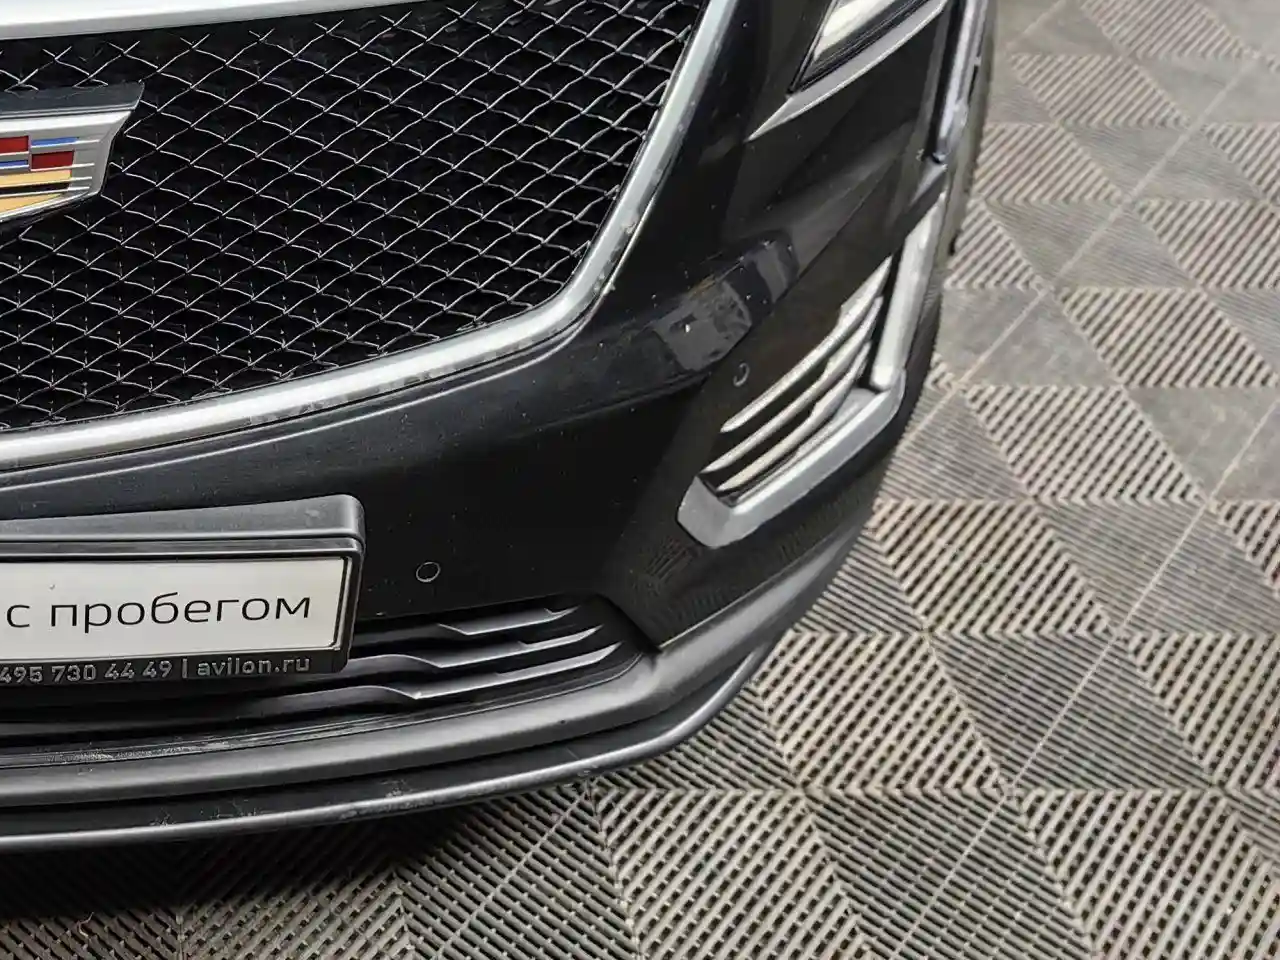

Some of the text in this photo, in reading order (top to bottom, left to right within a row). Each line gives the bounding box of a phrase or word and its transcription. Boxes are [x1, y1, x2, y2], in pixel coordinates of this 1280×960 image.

[6, 604, 31, 628] с
[50, 591, 311, 633] пробегом
[51, 664, 97, 682] 730
[103, 662, 136, 680] 44
[142, 660, 173, 678] 49
[197, 656, 311, 677] avilon.ru
